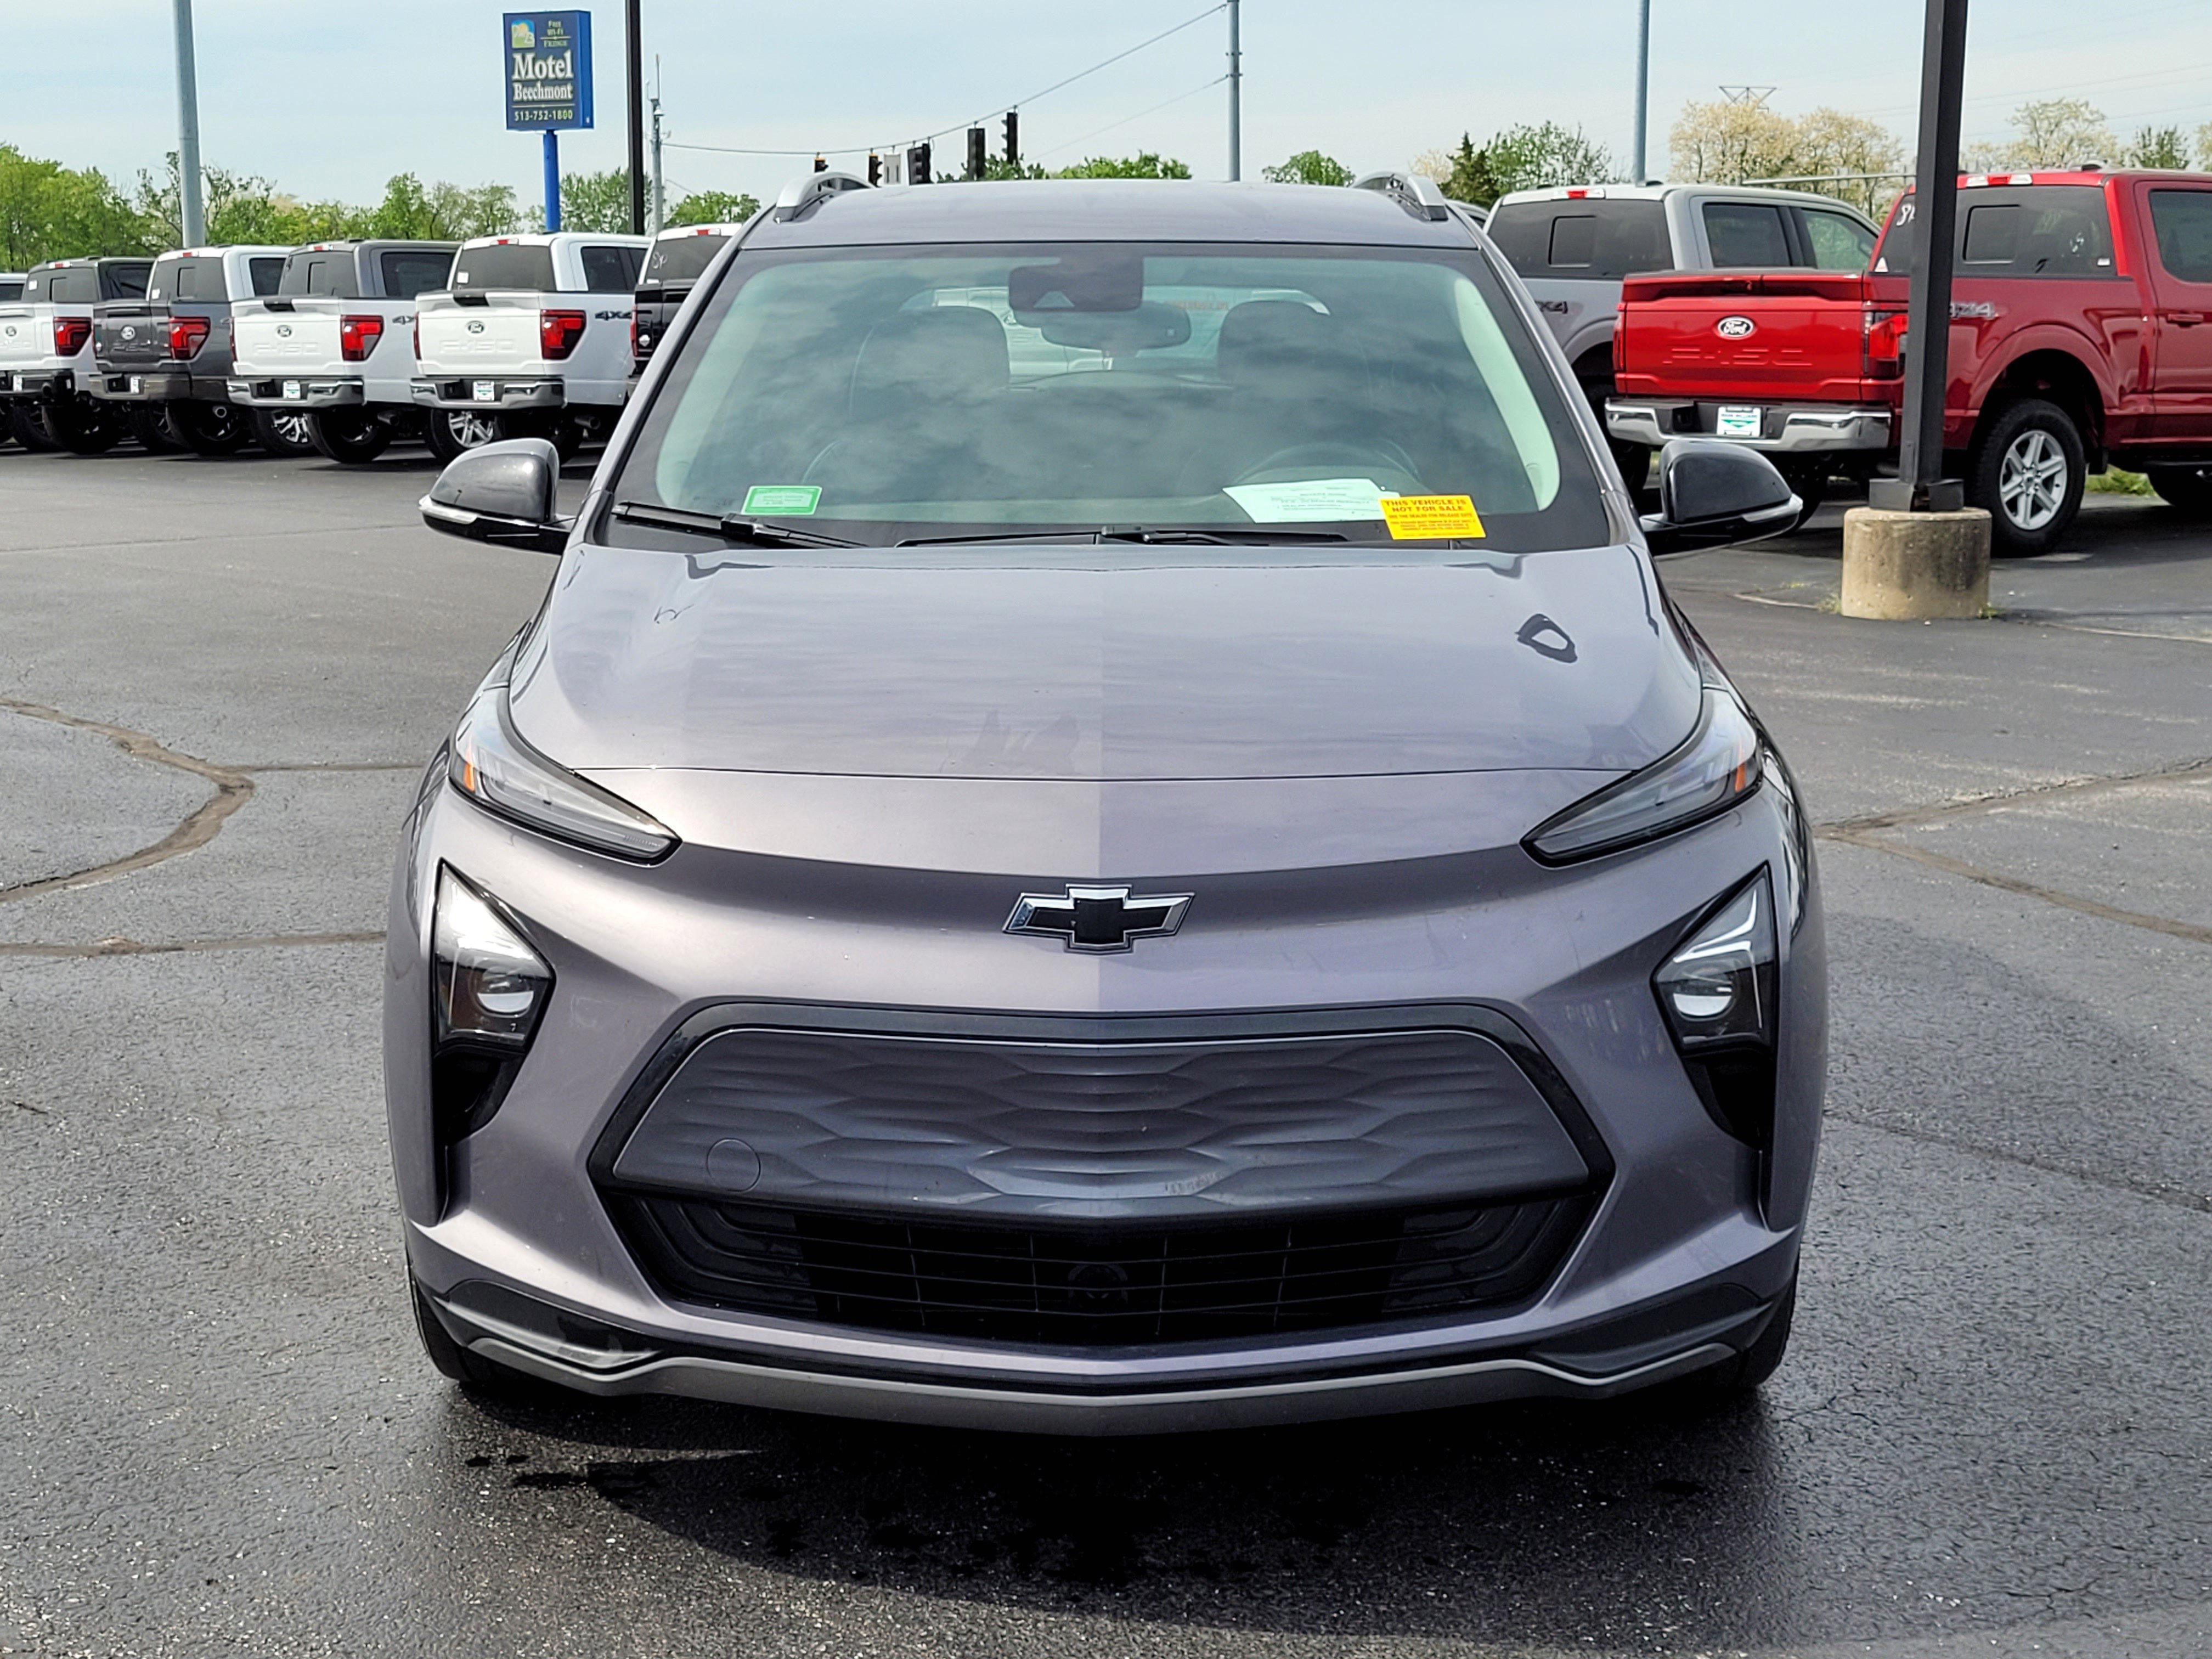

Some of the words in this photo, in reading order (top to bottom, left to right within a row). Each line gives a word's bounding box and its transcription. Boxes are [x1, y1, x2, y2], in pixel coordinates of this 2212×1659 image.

[512, 50, 574, 81] Motel
[513, 81, 573, 101] Beechmont
[515, 110, 573, 121] 513-752-1800
[1723, 321, 1747, 334] Ford
[438, 340, 517, 354] F-150
[1662, 346, 1813, 367] F-150
